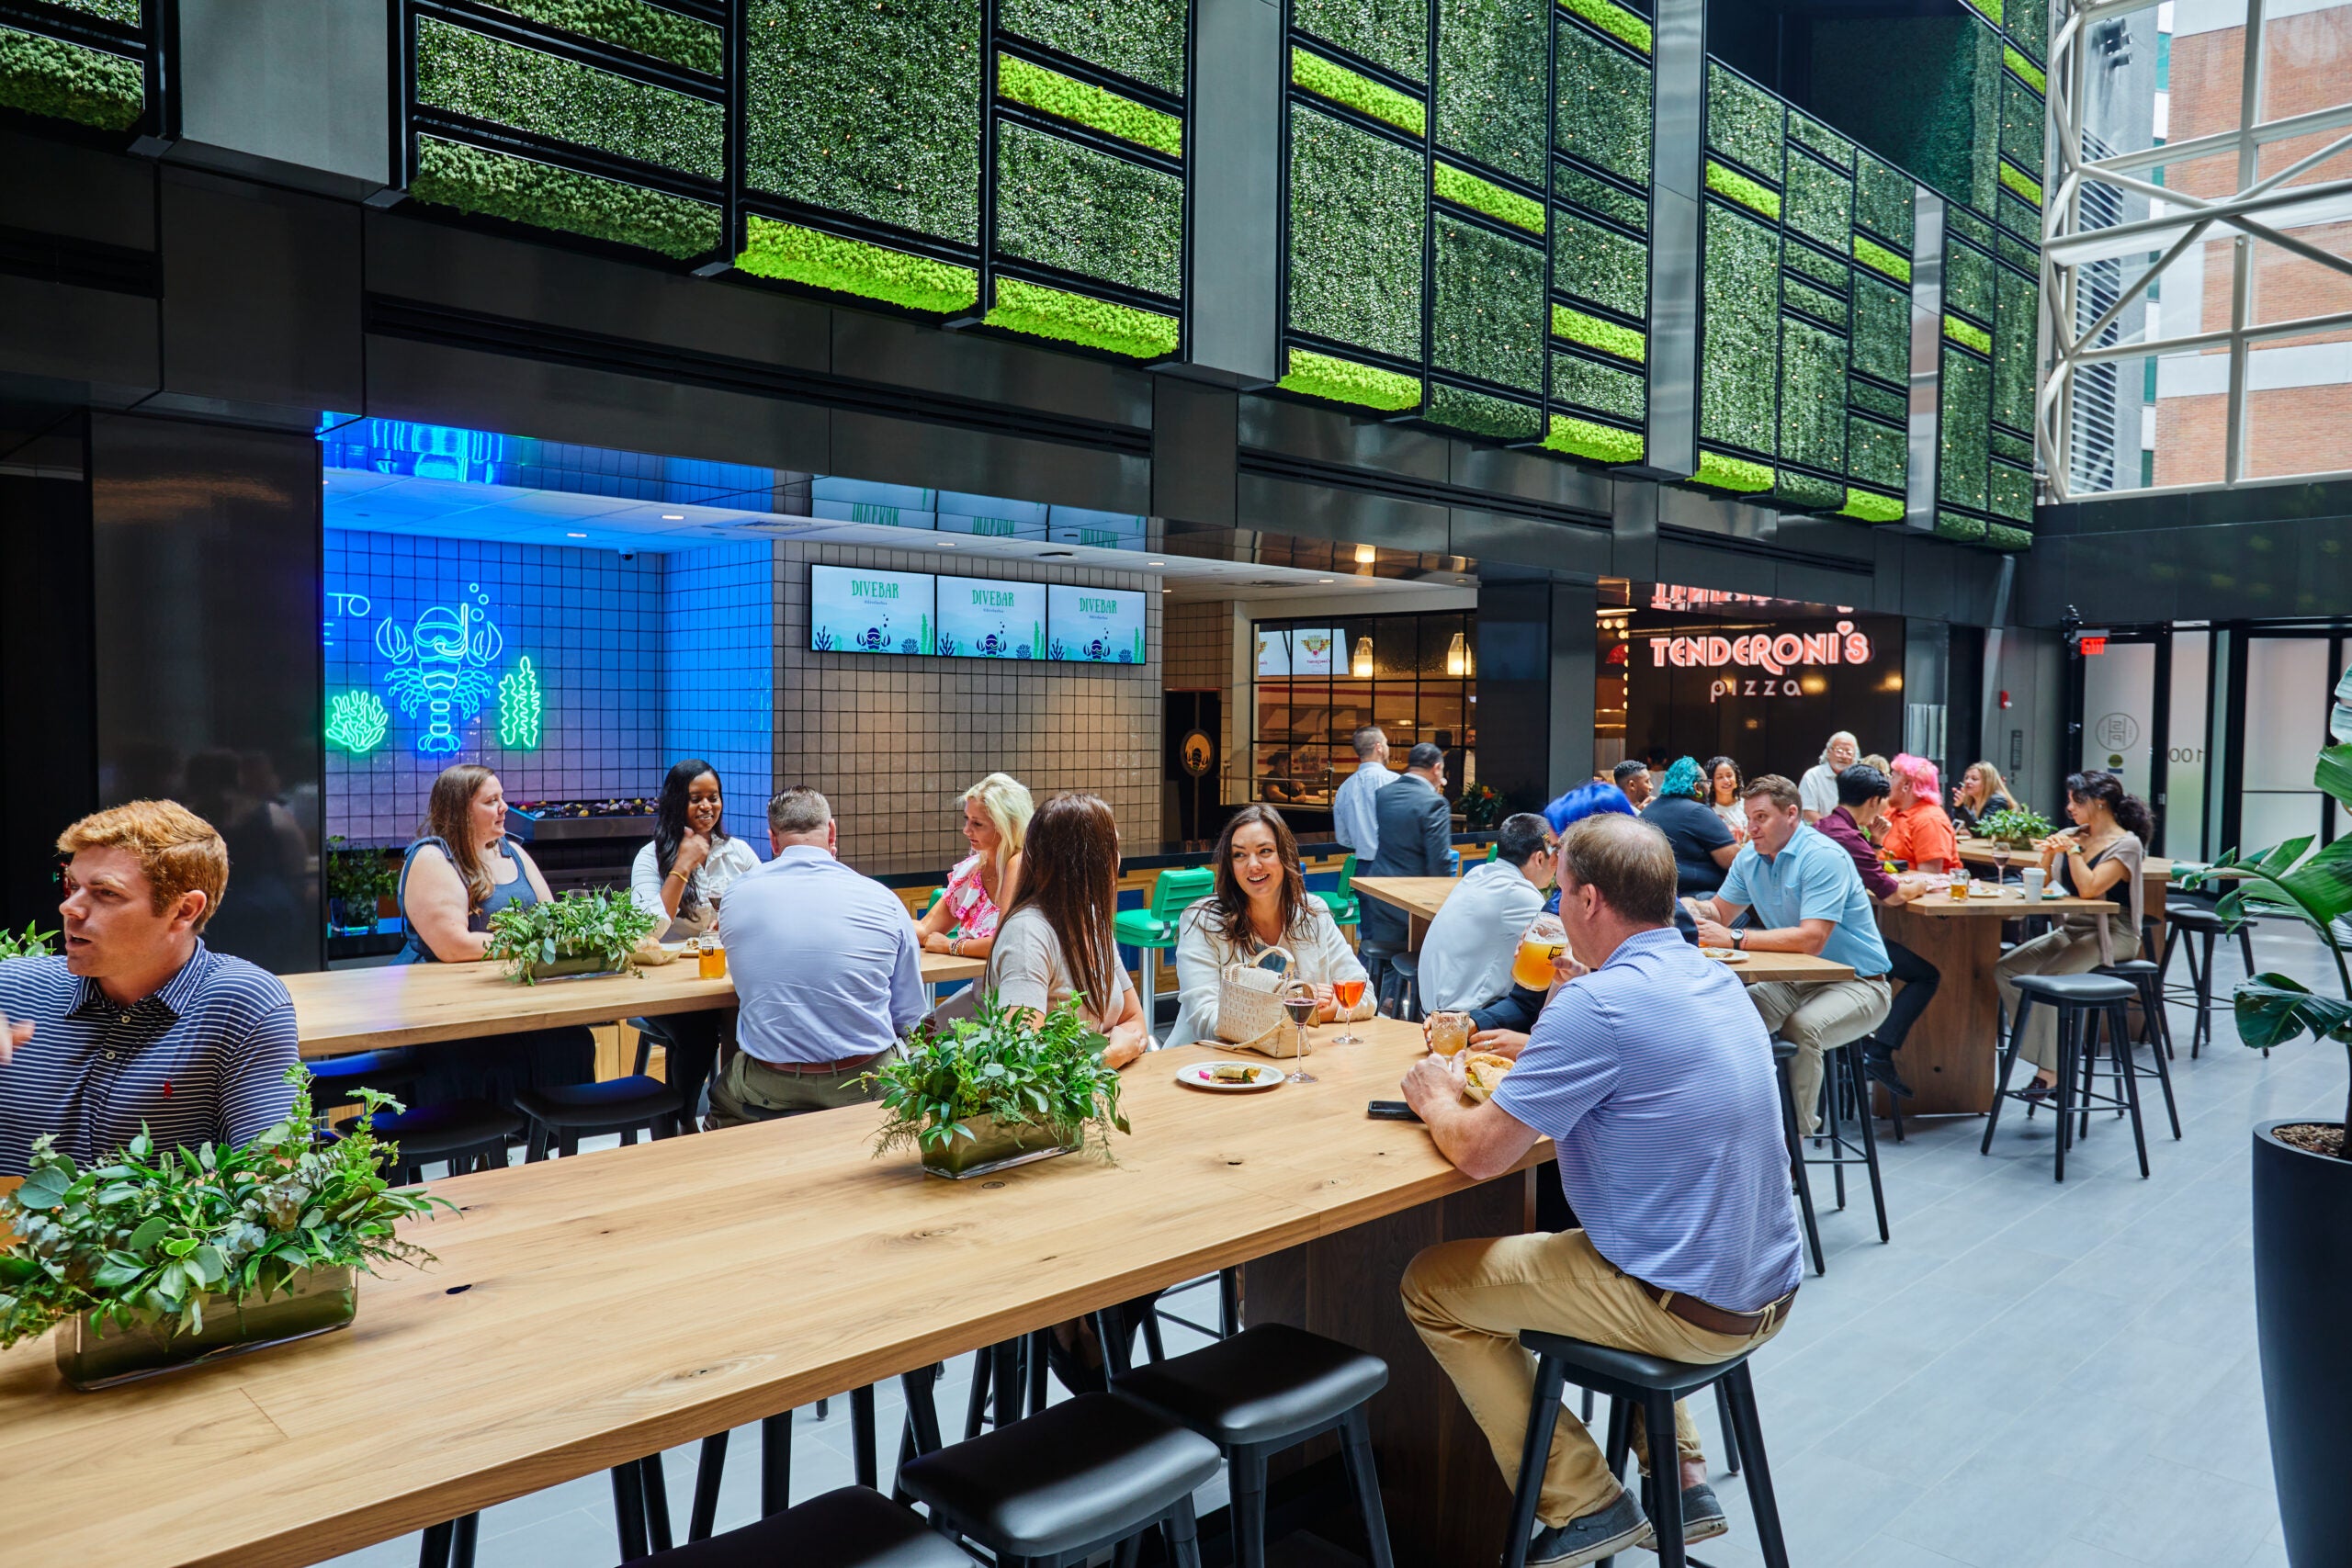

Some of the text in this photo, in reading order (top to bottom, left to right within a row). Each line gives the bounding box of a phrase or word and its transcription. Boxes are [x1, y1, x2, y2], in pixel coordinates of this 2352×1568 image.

[852, 580, 899, 599] DIVEBAR
[971, 589, 1014, 607] DIVEBAR
[326, 592, 370, 616] TO
[1079, 597, 1117, 615] DIVEBAR
[1650, 620, 1871, 676] TENDERONI'S
[2080, 637, 2106, 655] EXIT
[1710, 679, 1803, 704] pizza
